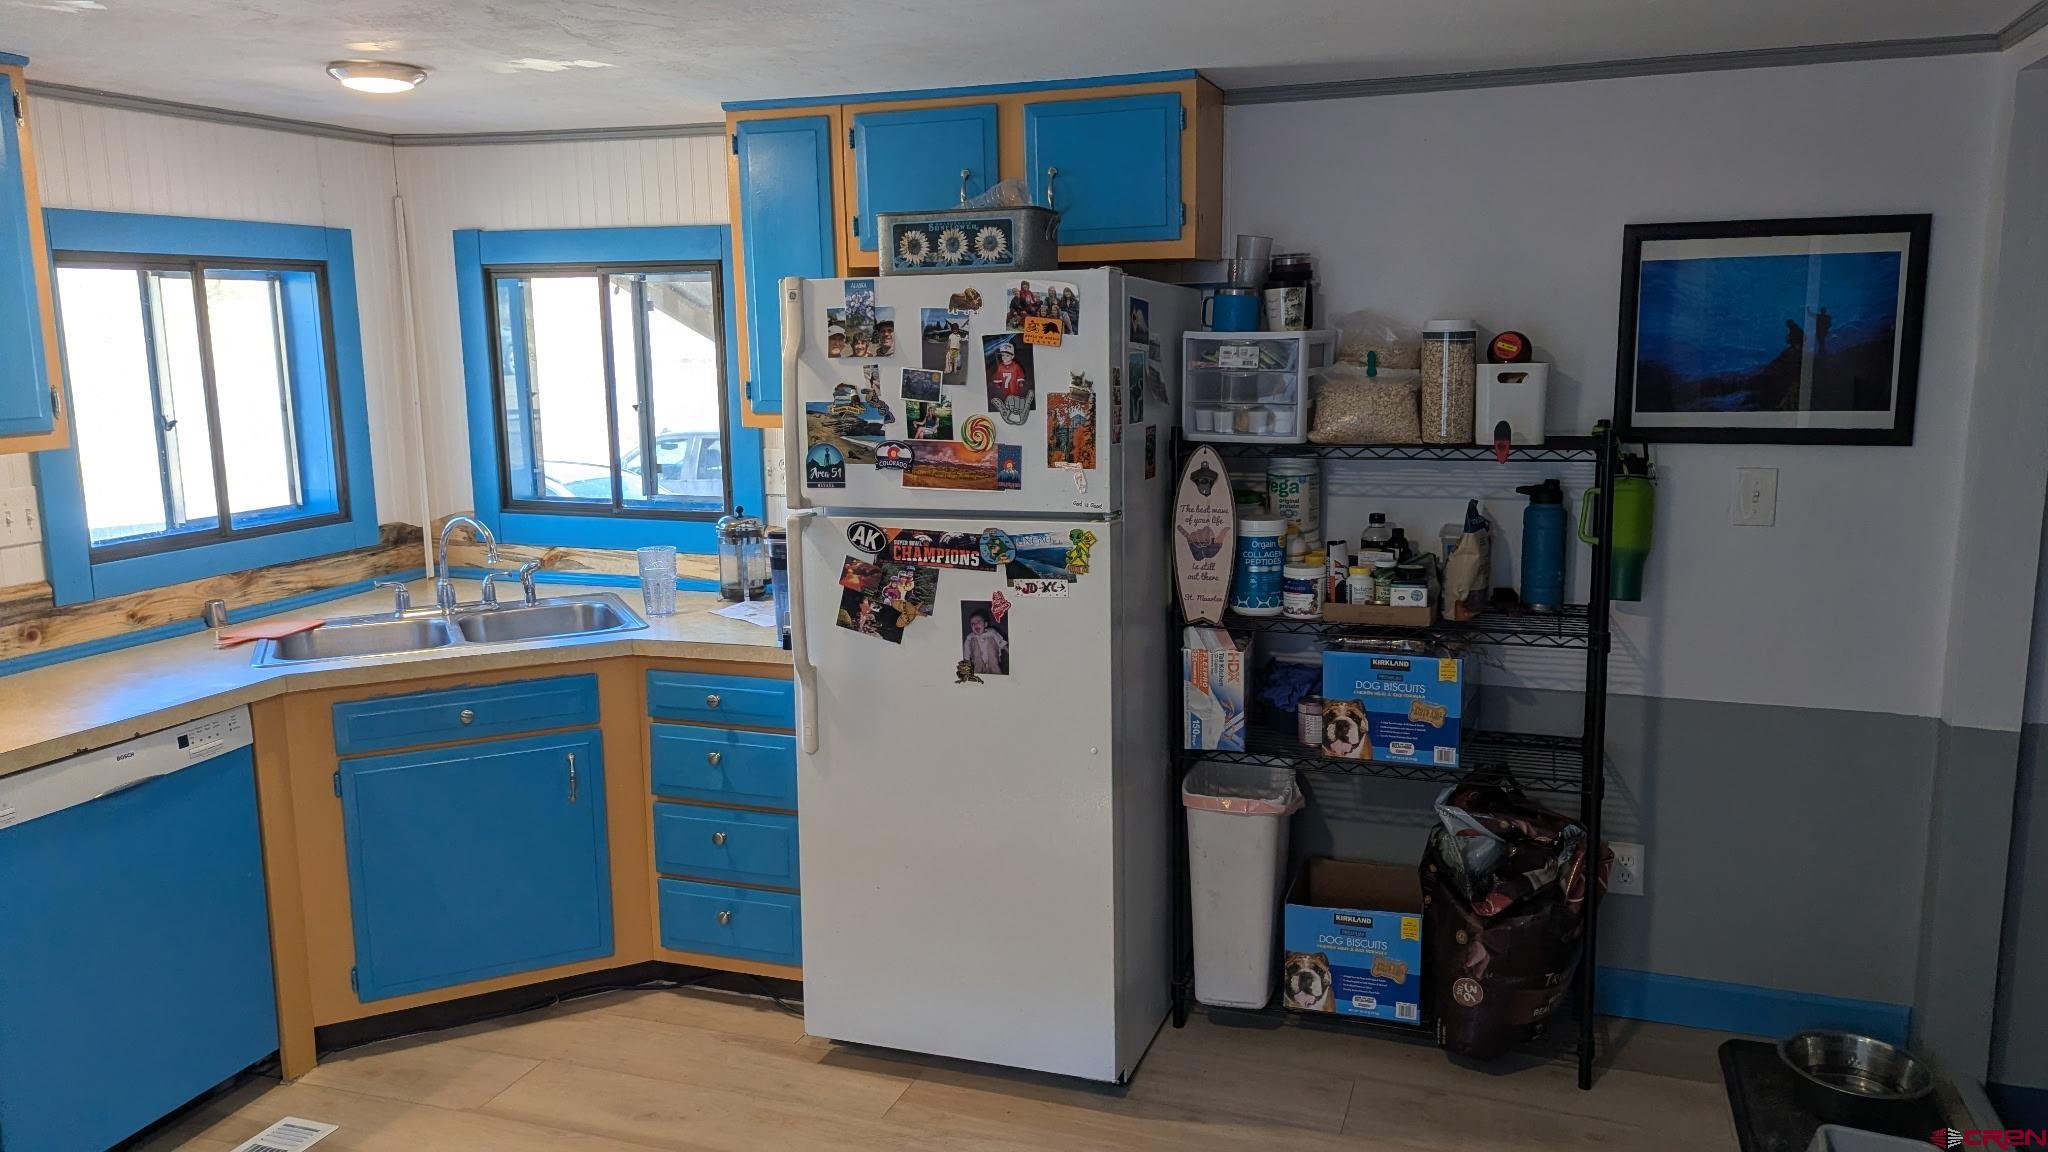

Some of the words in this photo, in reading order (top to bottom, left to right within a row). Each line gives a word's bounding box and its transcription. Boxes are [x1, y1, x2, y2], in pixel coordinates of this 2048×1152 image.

[1002, 372, 1012, 388] 7
[879, 460, 908, 468] COLORADO
[810, 466, 830, 480] Area
[831, 468, 842, 478] 51
[1270, 480, 1300, 498] ega
[1180, 504, 1194, 512] The
[852, 525, 880, 550] AK
[1252, 540, 1276, 550] Orgain
[893, 546, 980, 566] CHAMPIONS
[1245, 558, 1282, 566] PEPTIDES
[1228, 652, 1240, 683] HDX
[1372, 658, 1410, 668] KIRKLAND
[1355, 680, 1380, 690] DOG
[1384, 682, 1426, 694] BISCUITS
[1192, 720, 1200, 735] 150
[116, 752, 134, 762] BOSCH
[1336, 914, 1372, 925] KIRKLAND
[1319, 935, 1344, 946] DOG
[1346, 938, 1388, 950] BISCUITS
